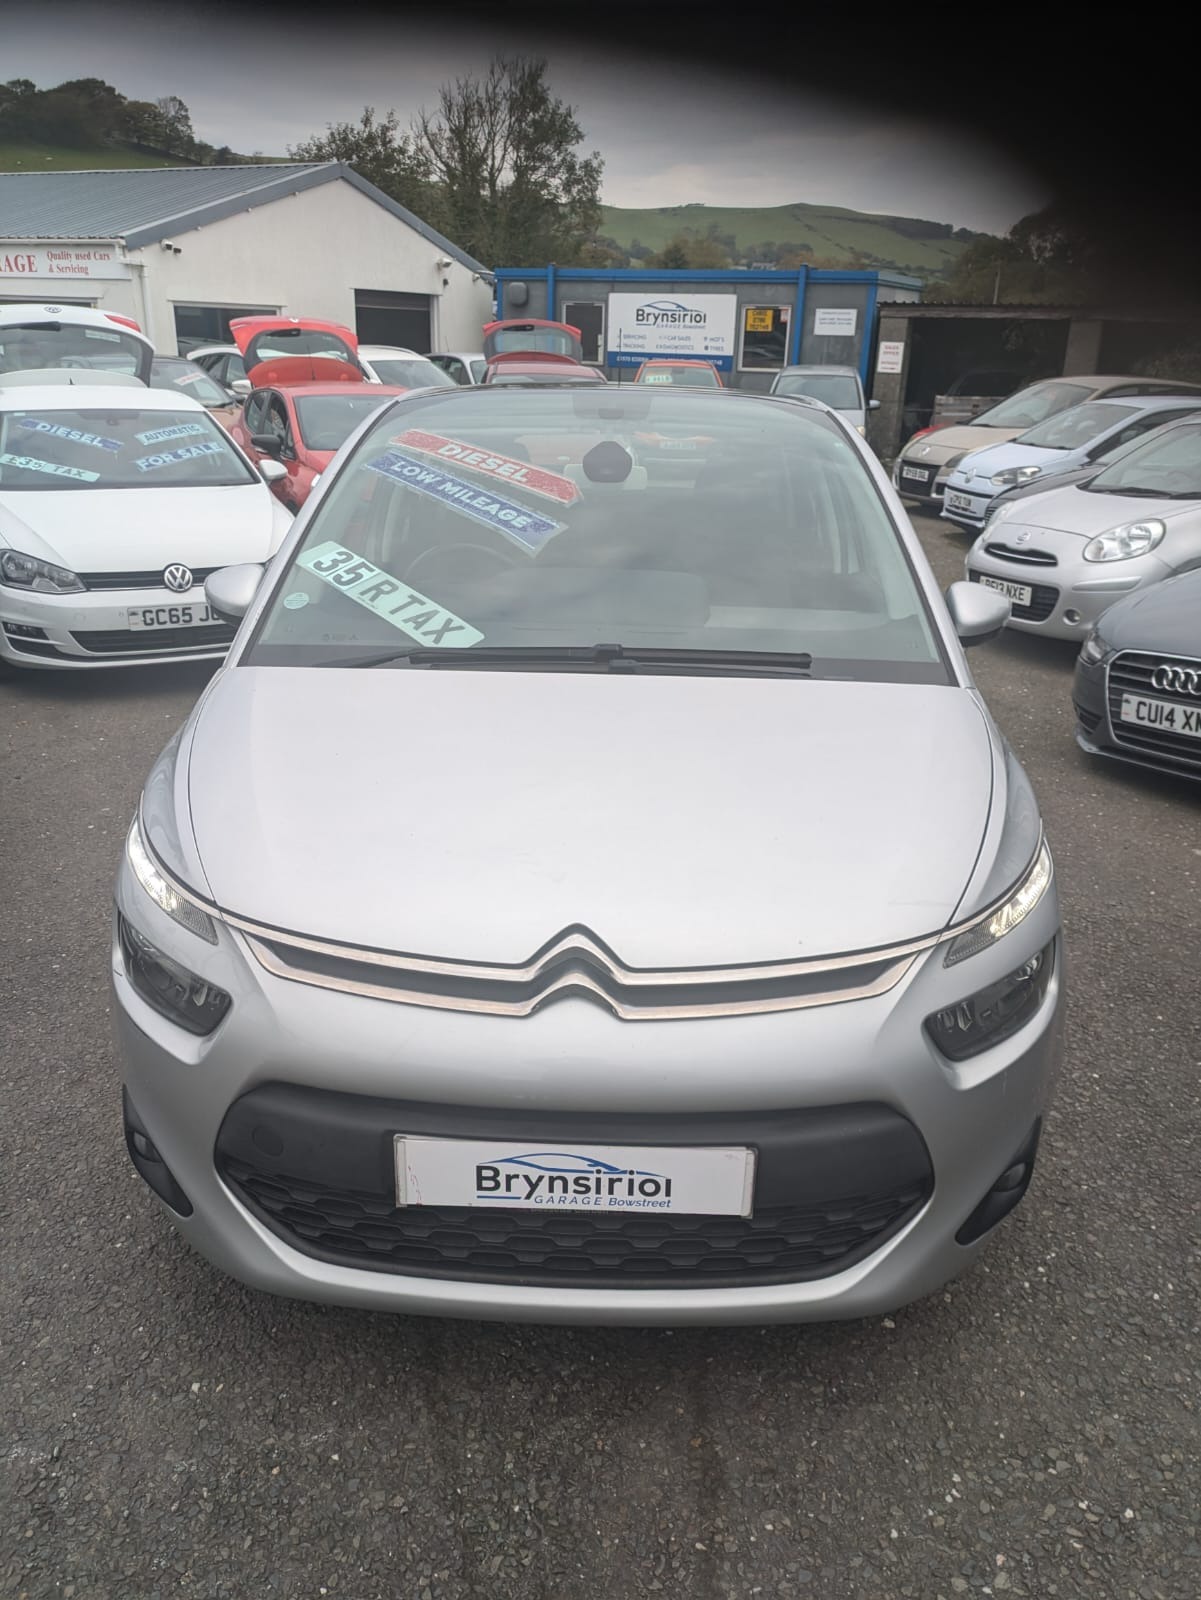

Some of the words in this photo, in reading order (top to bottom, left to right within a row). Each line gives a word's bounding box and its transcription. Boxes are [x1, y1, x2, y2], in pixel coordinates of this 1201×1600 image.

[0, 254, 38, 273] AGE
[47, 251, 73, 262] Quality
[74, 251, 91, 261] used
[94, 251, 111, 261] Cars
[56, 264, 89, 276] Servicing
[636, 308, 706, 326] Brynsiriol
[36, 422, 104, 448] DIESEL
[144, 425, 200, 442] AUTOMATIC
[138, 451, 176, 471] FOR
[180, 441, 223, 458] SALE
[438, 444, 531, 483] DIESEL
[53, 464, 86, 479] TAX
[391, 461, 440, 486] LOW
[439, 479, 533, 529] MILEAGE
[1006, 584, 1026, 602] NXE
[142, 607, 193, 626] GC65
[389, 594, 466, 645] TAX
[1136, 701, 1176, 727] CU14
[476, 1164, 672, 1200] Brynsiriol
[534, 1195, 604, 1206] GARAGE
[608, 1197, 672, 1208] Bowstreet
